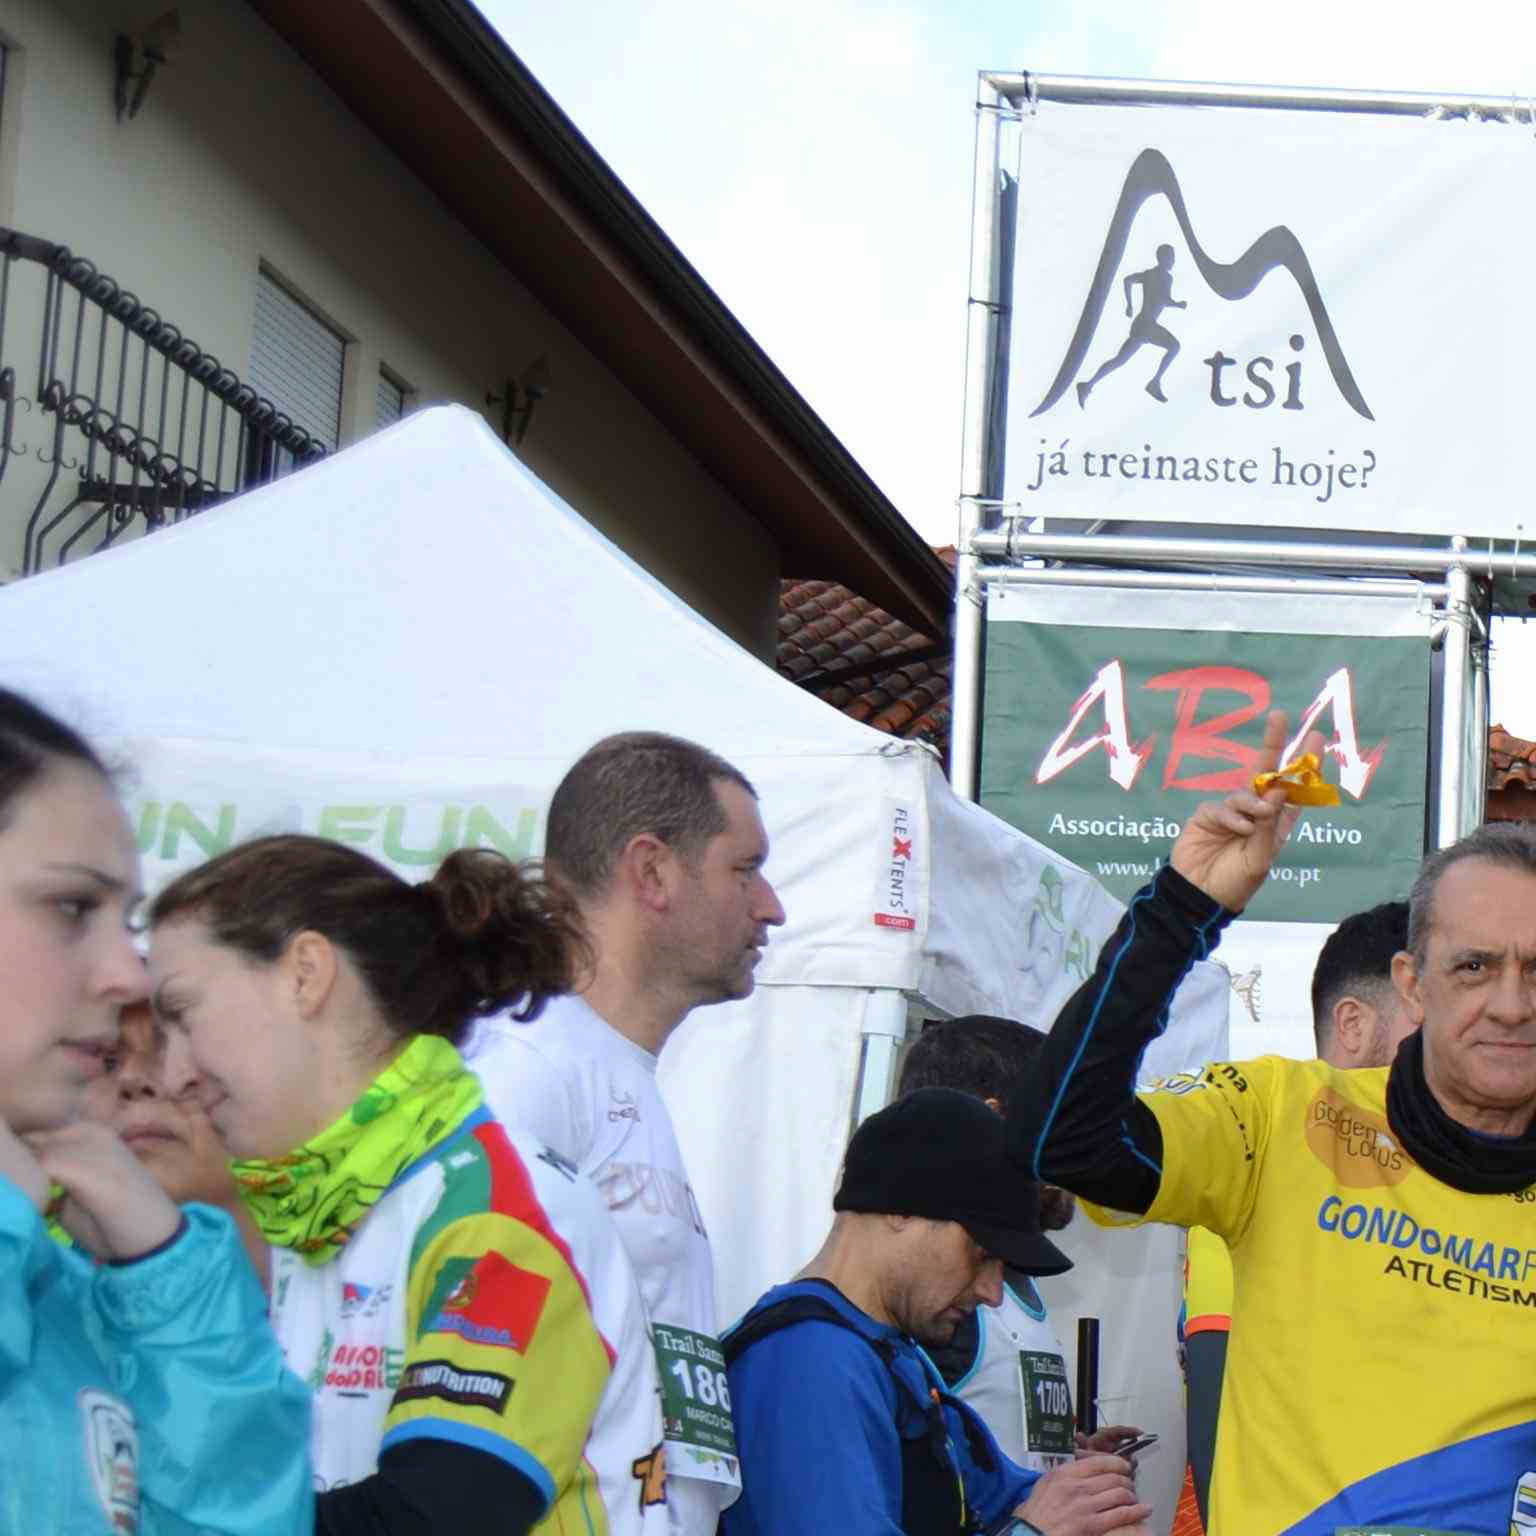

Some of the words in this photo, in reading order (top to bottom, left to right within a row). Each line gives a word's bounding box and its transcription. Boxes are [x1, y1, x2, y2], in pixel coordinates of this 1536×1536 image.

[1203, 334, 1305, 411] tsi
[1027, 438, 1070, 491] já
[1083, 444, 1258, 484] treinaste
[1272, 447, 1377, 503] hoje?
[1034, 658, 1389, 800] ABA
[1048, 812, 1180, 843] Associação
[1297, 823, 1362, 846] Ativo
[889, 807, 912, 909] FLEXTENTS
[1314, 1100, 1378, 1146] Golden
[1346, 1134, 1402, 1171] Lotus
[656, 1329, 694, 1356] Trail
[696, 1338, 726, 1367] San
[671, 1359, 732, 1413] 186
[1036, 1380, 1068, 1416] 1708
